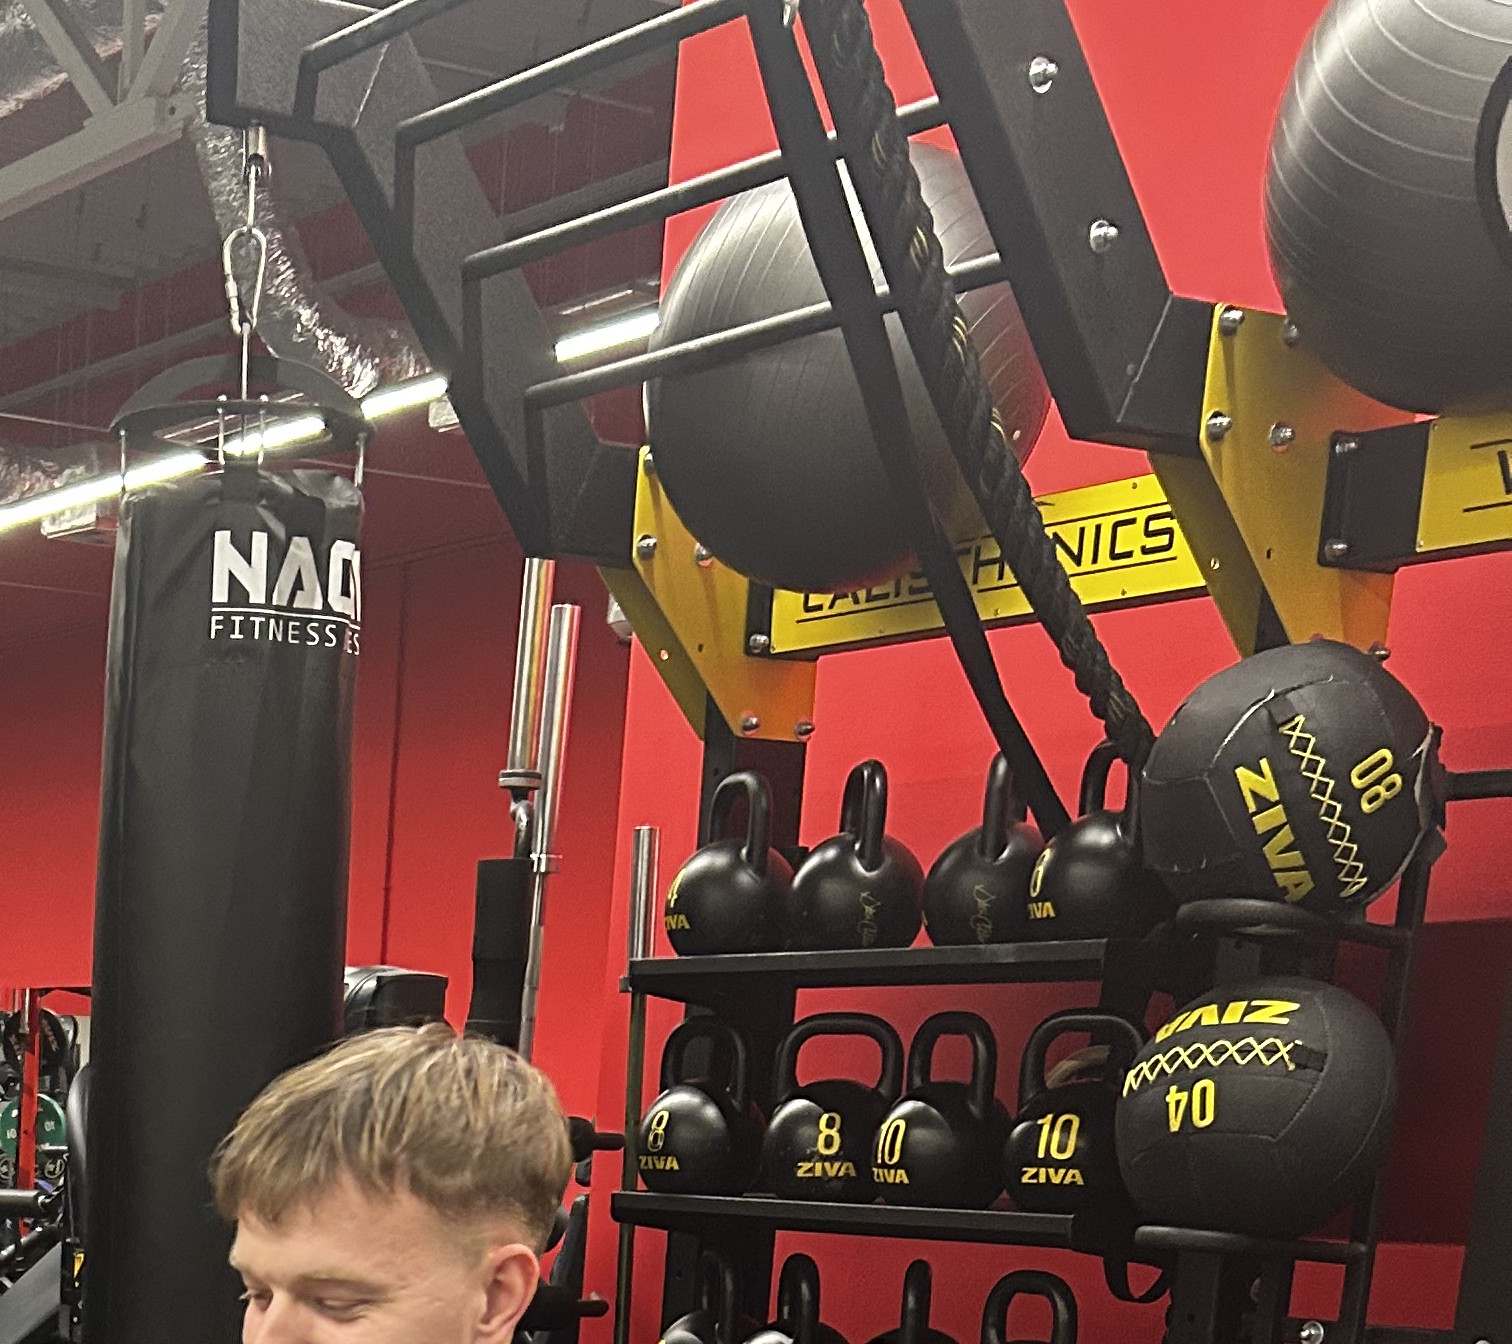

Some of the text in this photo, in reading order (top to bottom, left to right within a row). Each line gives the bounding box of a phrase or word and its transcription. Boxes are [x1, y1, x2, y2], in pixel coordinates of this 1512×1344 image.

[210, 616, 337, 647] FITNESS
[1350, 748, 1403, 814] 08
[1234, 757, 1315, 901] ZIVA
[1155, 1000, 1300, 1043] ZIVA
[1165, 1078, 1215, 1133] 04
[647, 1110, 670, 1152] 8
[817, 1112, 842, 1156] 8
[876, 1118, 906, 1165] 10
[1036, 1113, 1081, 1160] 10
[639, 1155, 680, 1171] ZIVA
[796, 1161, 857, 1178] ZIVA
[872, 1167, 910, 1184] ZIVA
[1020, 1166, 1085, 1186] ZIVA
